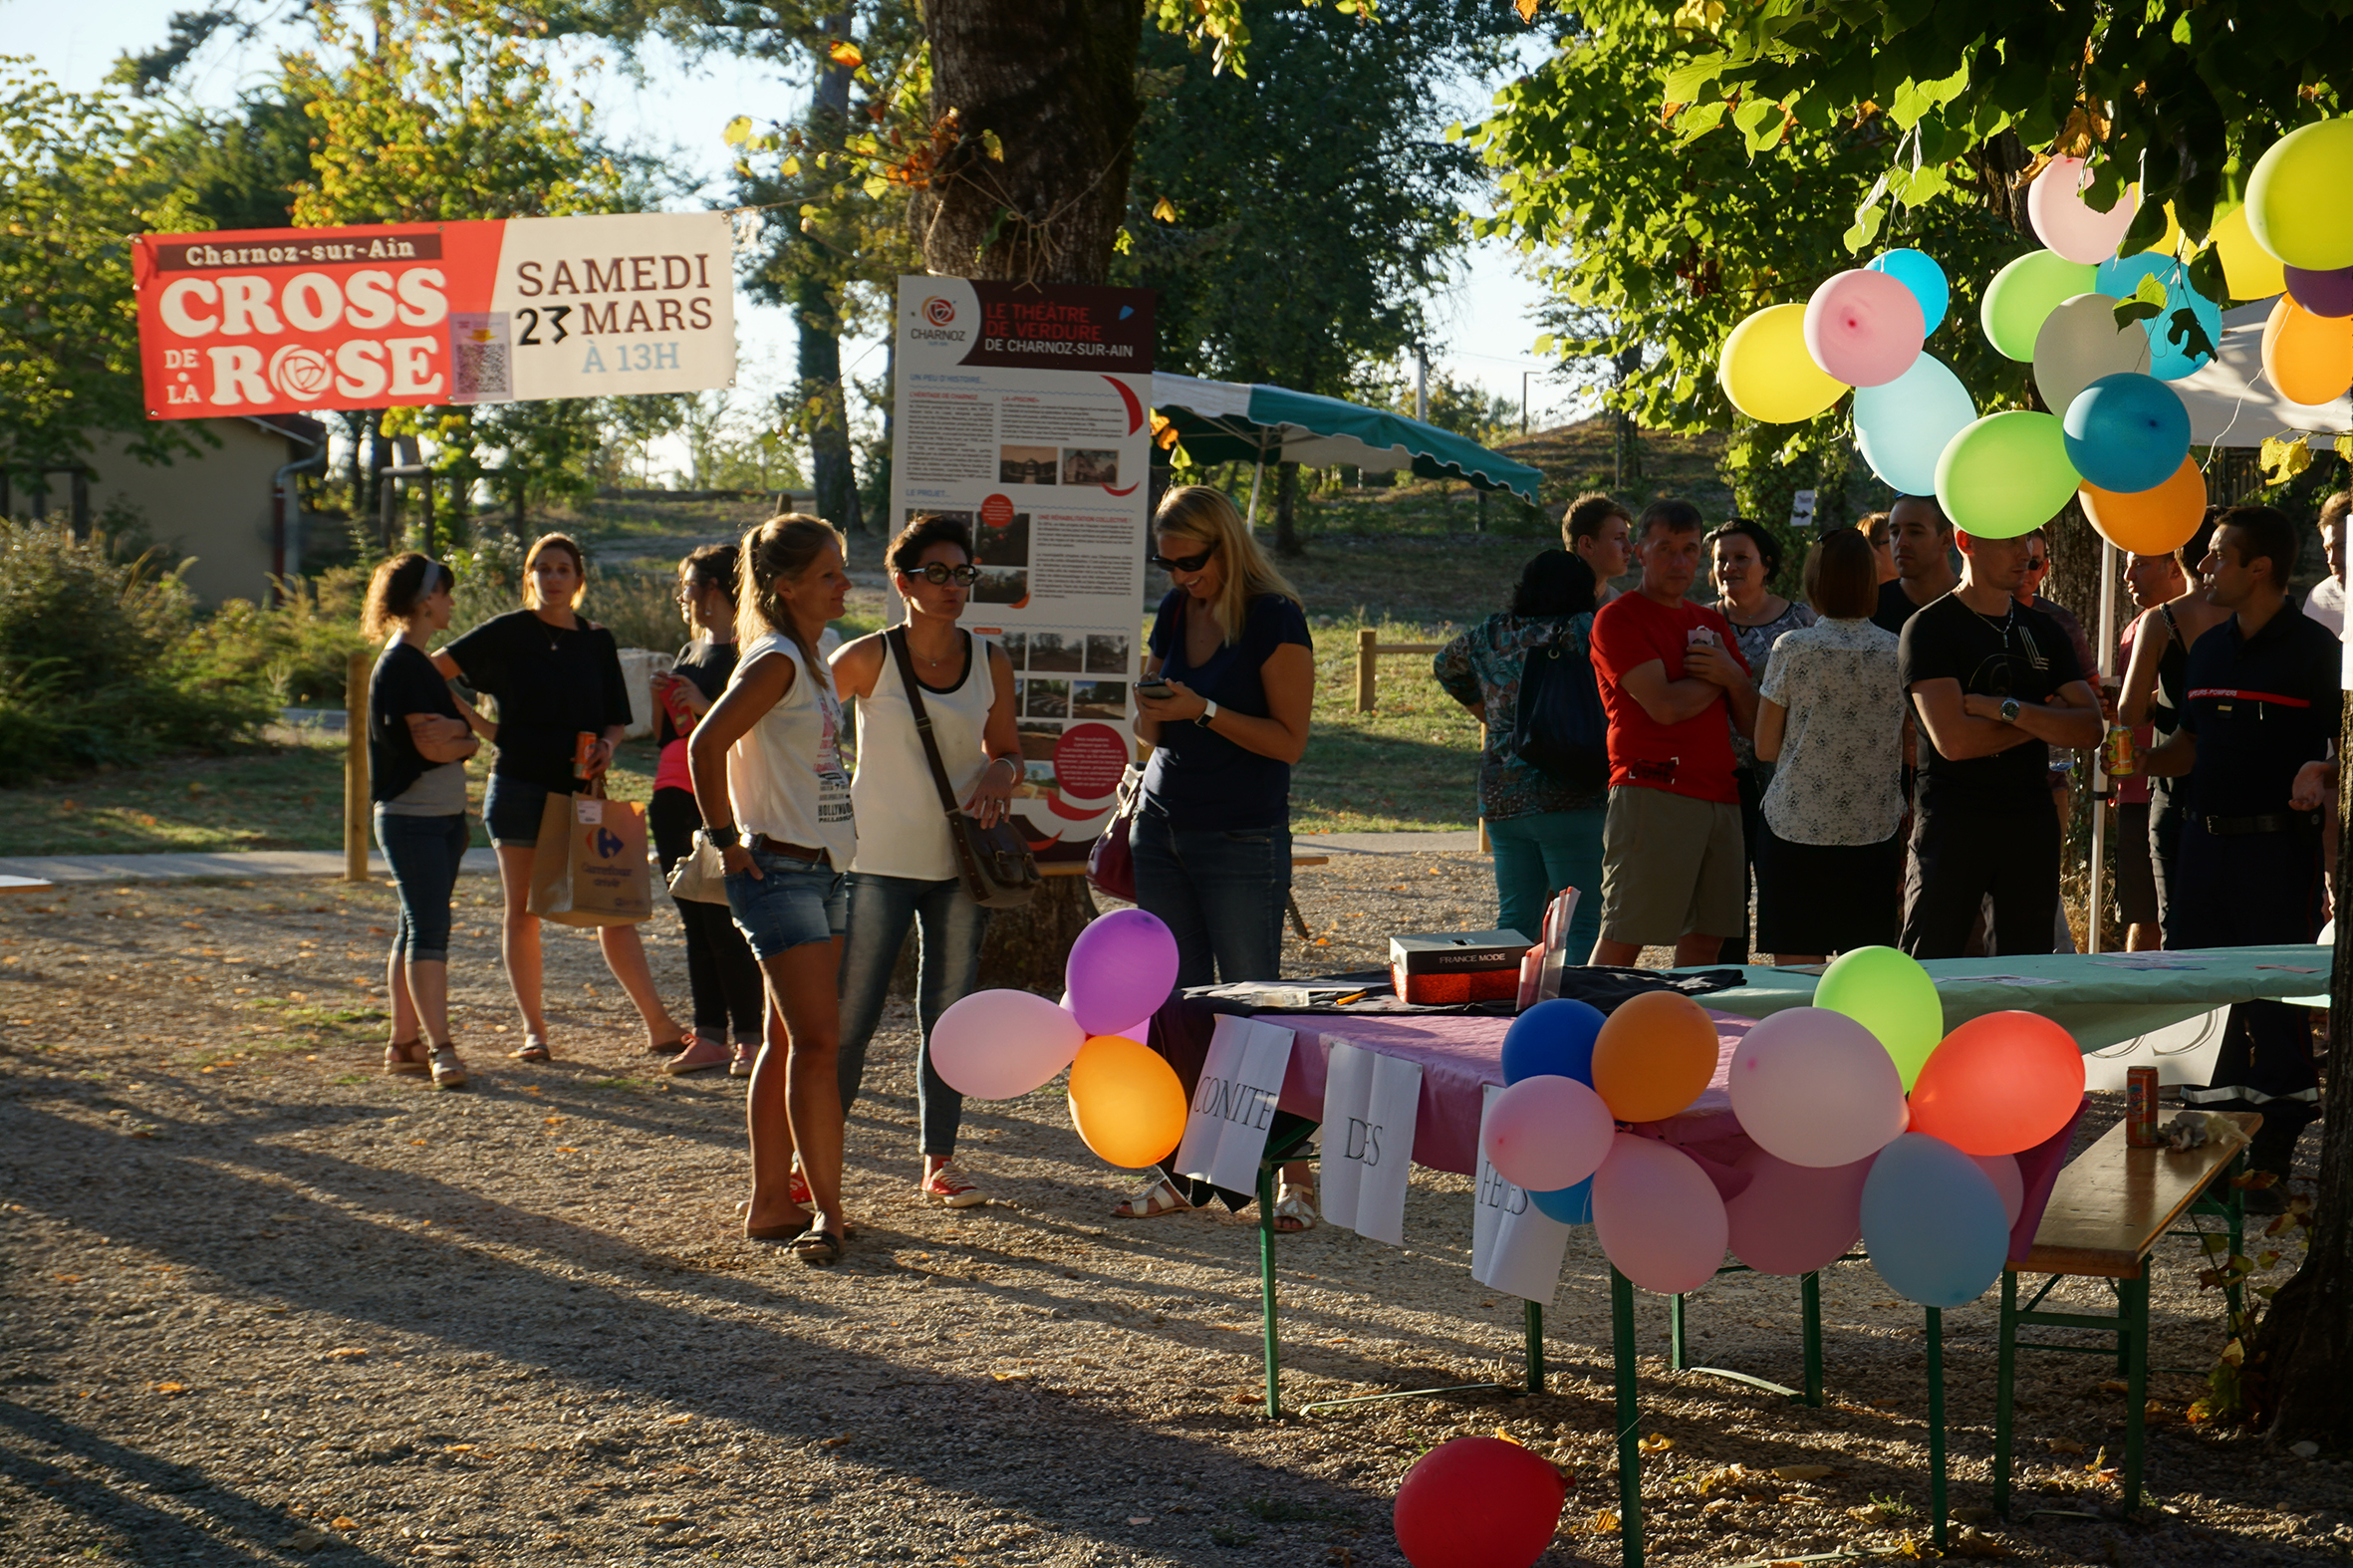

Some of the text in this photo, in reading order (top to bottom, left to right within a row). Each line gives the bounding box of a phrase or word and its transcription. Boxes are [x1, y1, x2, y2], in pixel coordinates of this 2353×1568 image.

[186, 237, 415, 266] Charnoz-sur-Ain
[517, 253, 710, 297] SAMEDI
[159, 267, 448, 338] CROSS
[986, 301, 1090, 324] LE THÉÂTRE
[515, 297, 712, 346] 23 MARS
[985, 320, 1103, 342] DE VERDURE
[911, 328, 965, 342] CHARNOZ
[164, 349, 199, 369] DE
[581, 340, 680, 374] À 13H
[984, 338, 1134, 358] DE CHARNOZ-SUR-AIN
[206, 336, 444, 405] ROSE
[166, 385, 200, 403] LA
[581, 862, 633, 877] Carrefour
[1439, 954, 1477, 964] FRANCE
